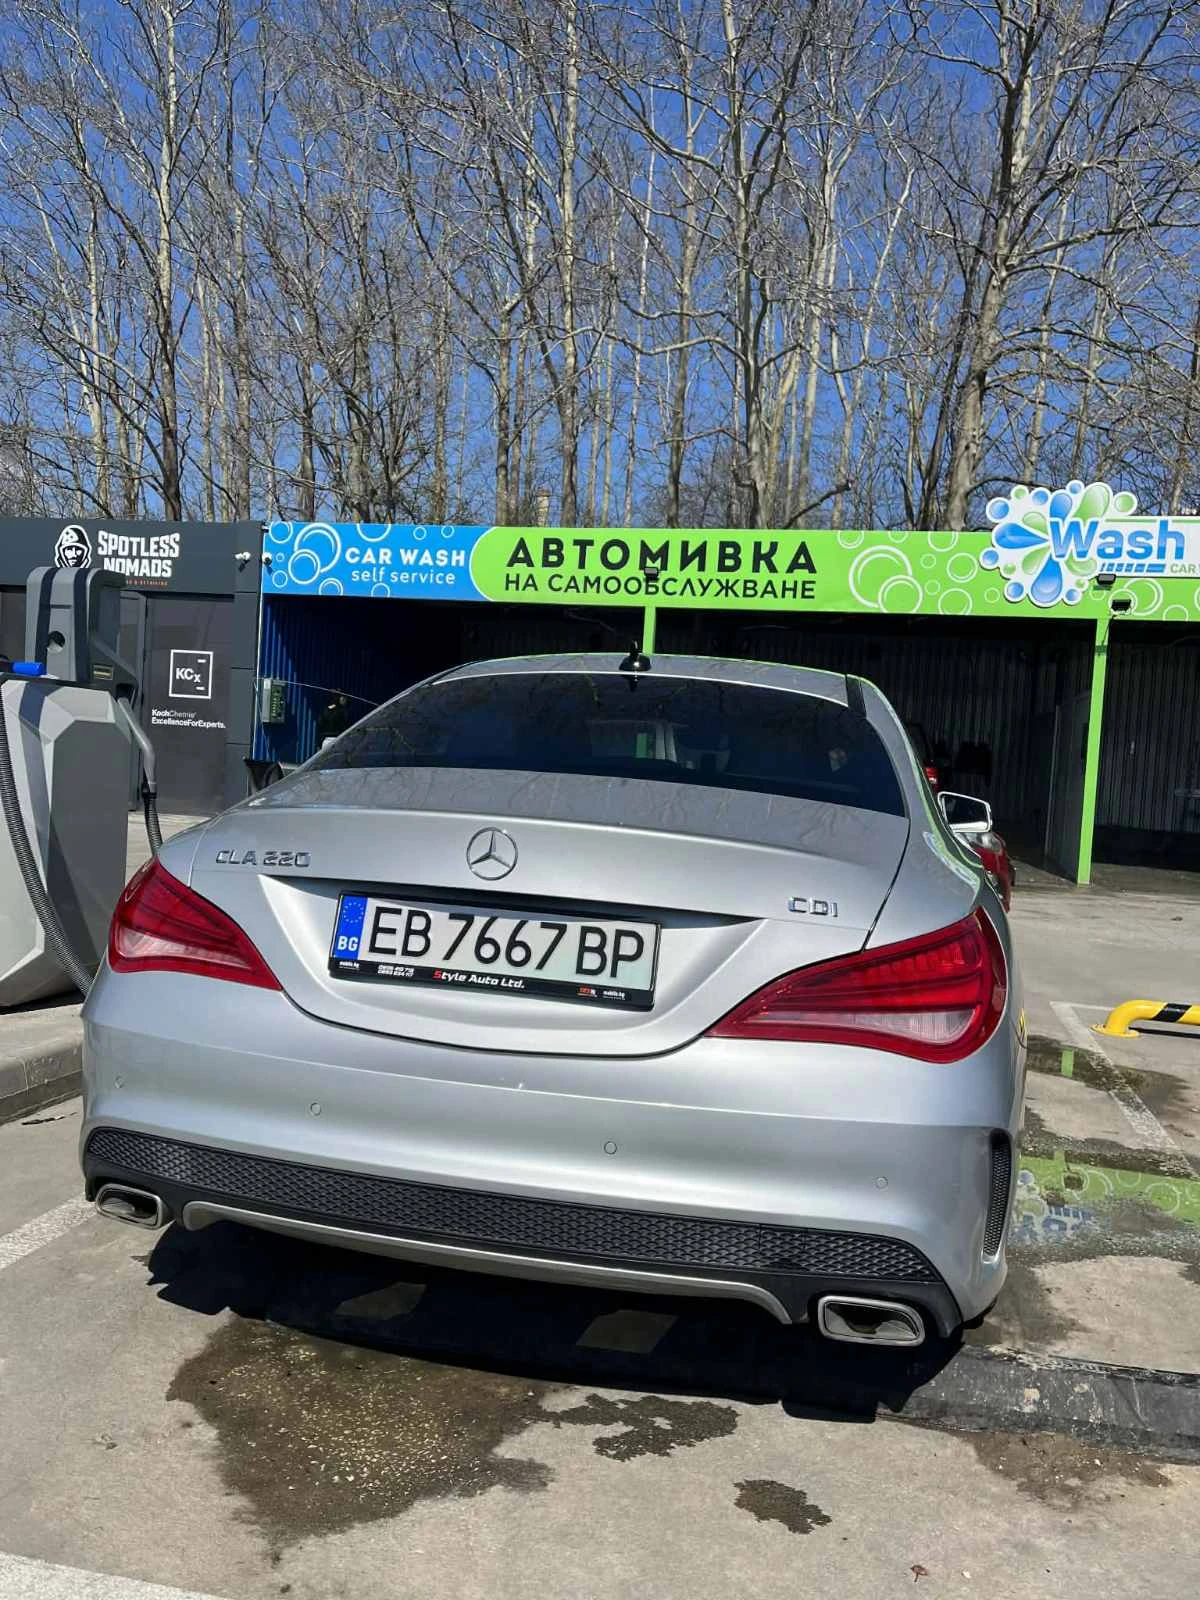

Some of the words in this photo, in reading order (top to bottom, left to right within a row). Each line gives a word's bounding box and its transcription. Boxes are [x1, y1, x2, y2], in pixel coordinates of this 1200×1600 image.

[97, 530, 181, 558] SPOTLESS
[1049, 519, 1186, 561] Wash
[345, 547, 392, 564] CAR
[399, 548, 466, 567] WASH
[506, 537, 817, 574] АВТОМИВКА
[103, 557, 172, 578] NOMADS
[351, 566, 386, 583] self
[390, 570, 456, 584] service
[1170, 563, 1197, 574] CAR
[504, 573, 539, 592] НА
[547, 573, 817, 600] САМООБСЛУЖВАНЕ
[215, 849, 257, 865] CLA
[263, 850, 311, 867] 220
[788, 896, 839, 917] CDI
[337, 935, 359, 952] BG
[368, 906, 432, 958] EB
[442, 912, 568, 970] 7667
[575, 926, 645, 978] BP
[432, 969, 467, 982] Style
[468, 974, 499, 985] Auto
[500, 977, 525, 989] Ltd.
